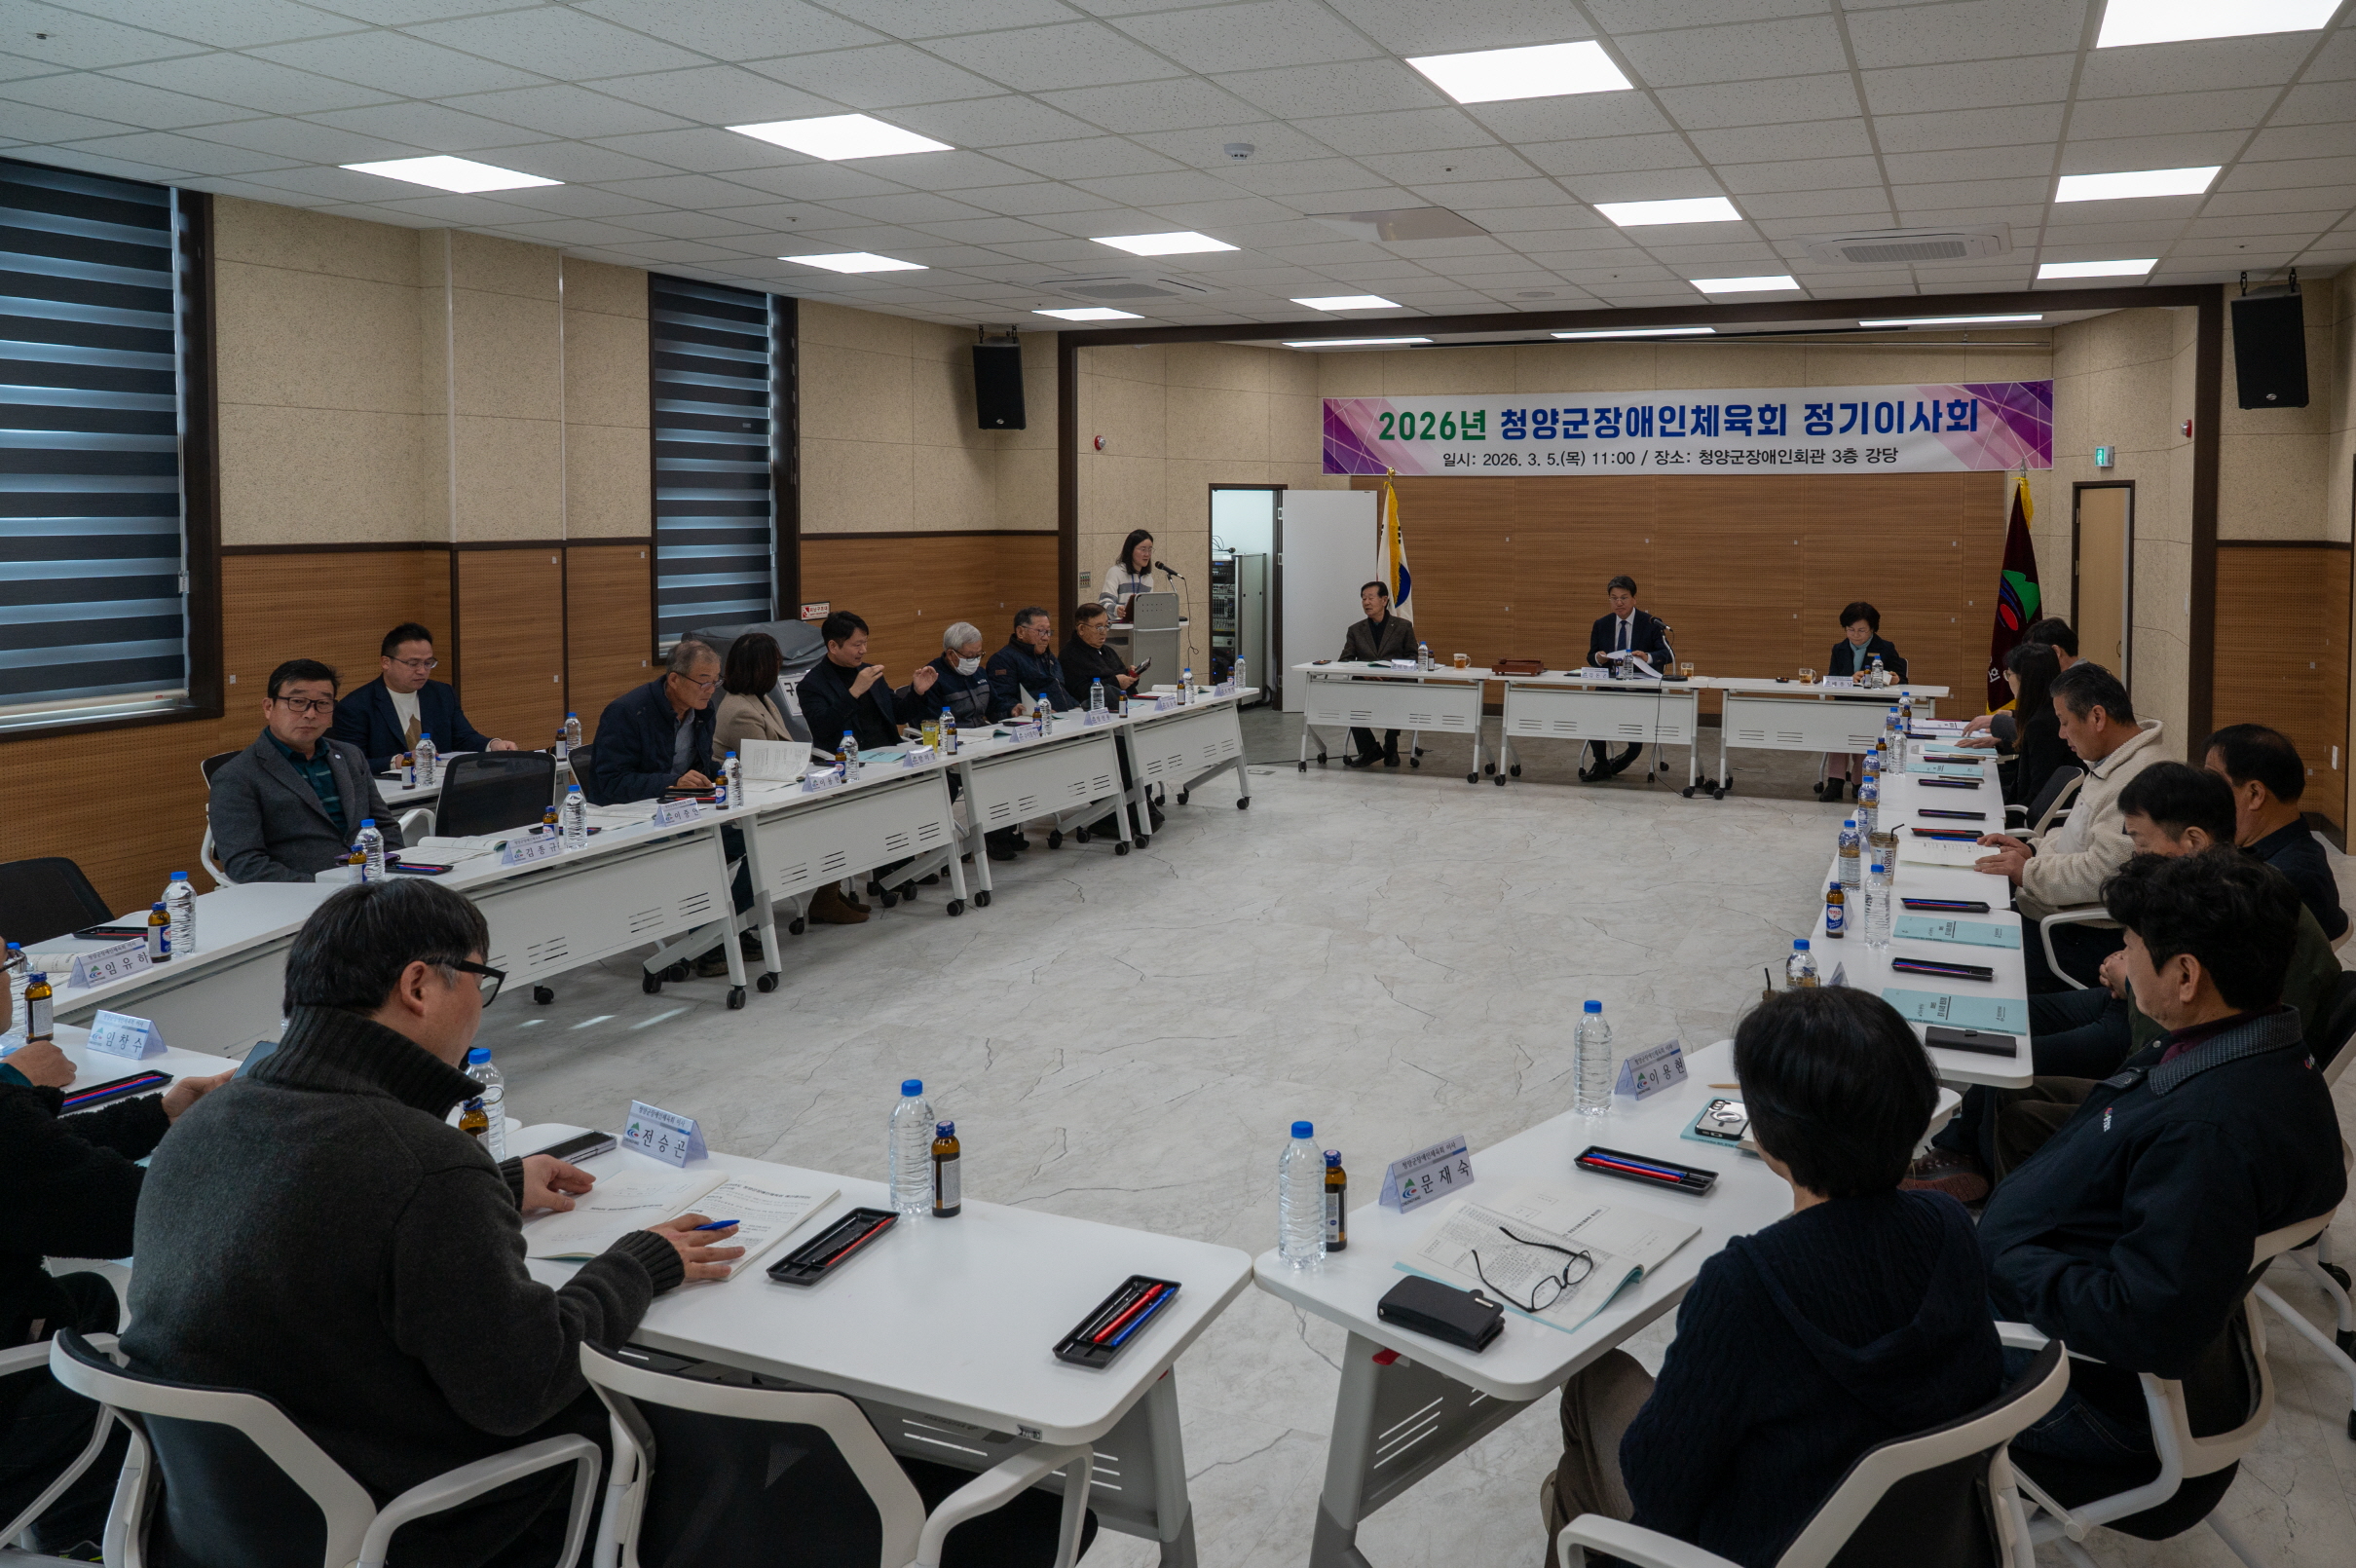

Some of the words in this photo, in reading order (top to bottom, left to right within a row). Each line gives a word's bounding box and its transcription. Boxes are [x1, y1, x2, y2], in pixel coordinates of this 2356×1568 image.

[1378, 409, 1486, 441] 2026년
[1500, 403, 1786, 440] 청양군장애인체육회
[1804, 398, 1978, 436] 정기이사회
[1442, 452, 1476, 467] 일시:
[1483, 453, 1521, 467] 2026.
[1528, 452, 1541, 467] 3.
[1547, 450, 1586, 468] 5.(목)
[1592, 451, 1635, 466] 11:00
[1654, 449, 1691, 465] 장소:
[1699, 448, 1826, 466] 청양군장애인회관
[1832, 447, 1858, 464] 3층
[1865, 447, 1898, 464] 강당
[1402, 1146, 1445, 1171] 청양군장애인체육회
[1445, 1141, 1456, 1151] 이사
